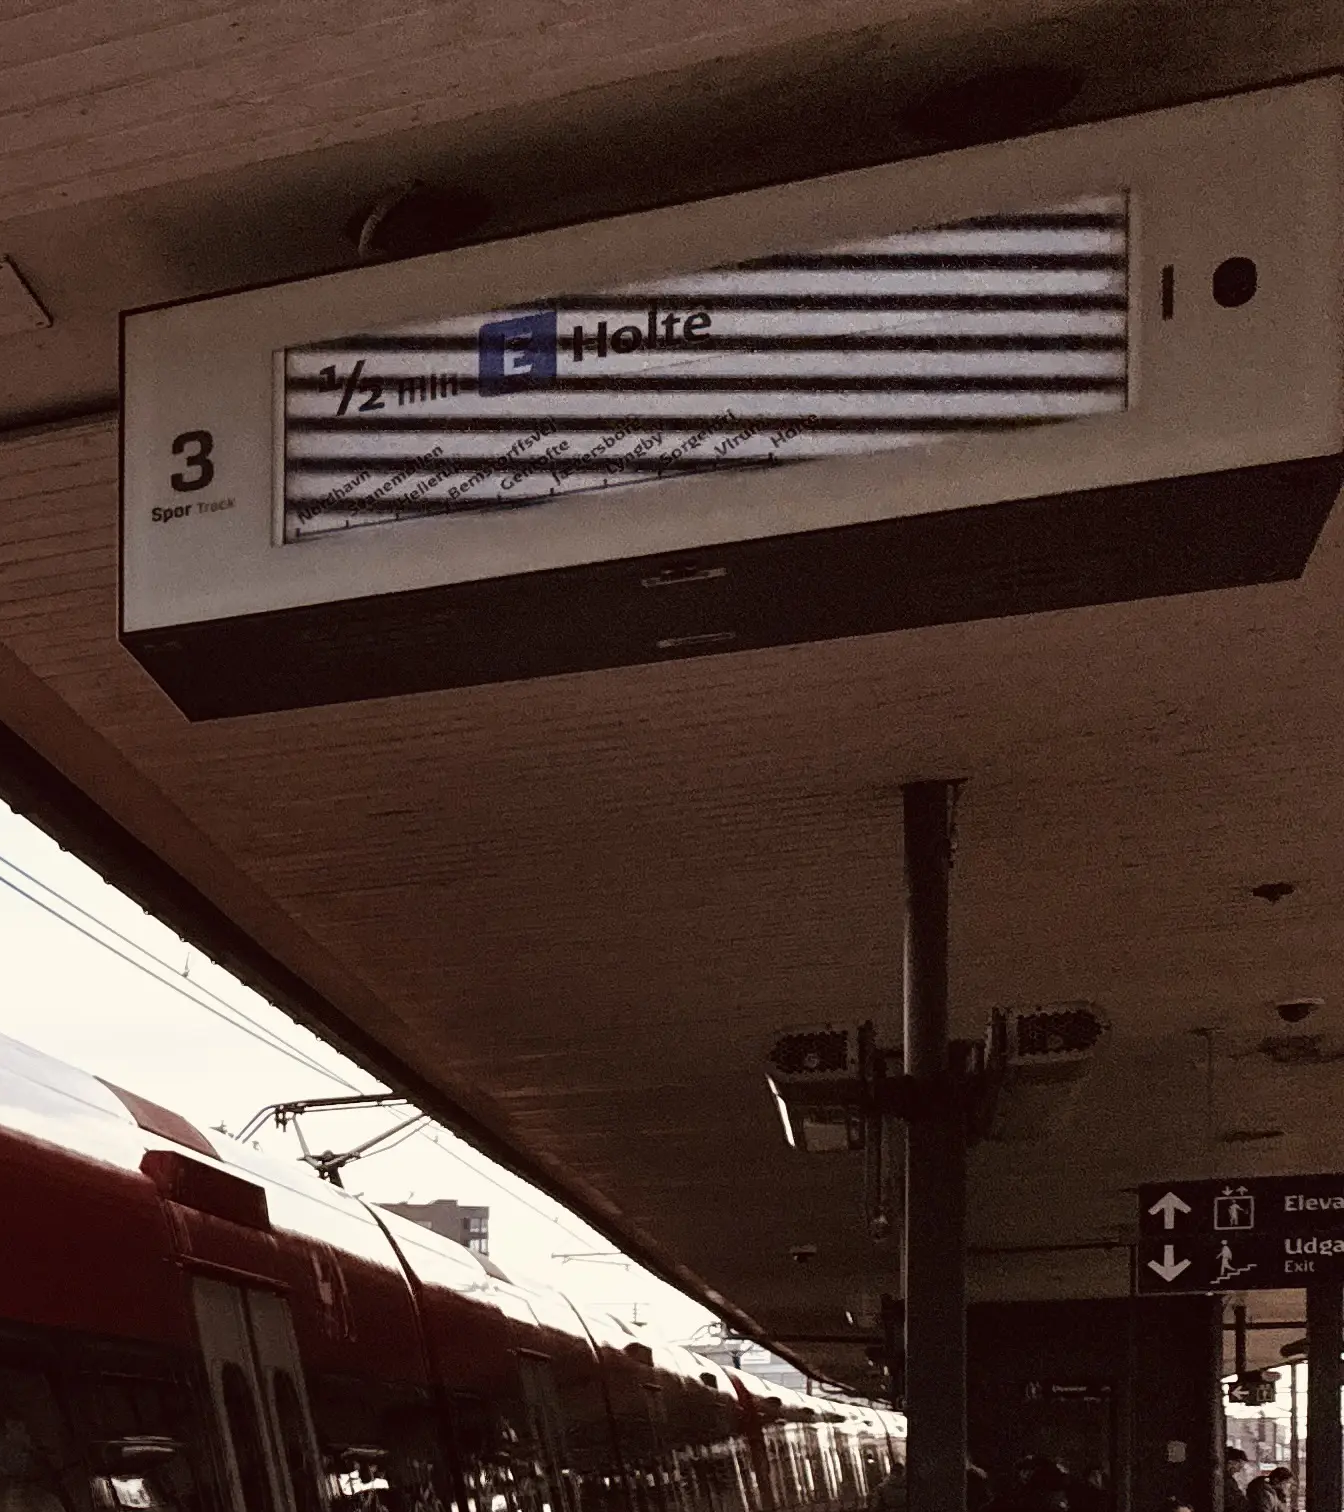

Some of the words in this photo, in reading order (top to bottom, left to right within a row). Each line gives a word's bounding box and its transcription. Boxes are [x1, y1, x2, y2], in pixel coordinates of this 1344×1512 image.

[573, 299, 712, 362] Holte
[503, 331, 534, 377] E
[171, 430, 214, 492] 3
[151, 504, 193, 523] Spor
[197, 497, 237, 514] Track
[1284, 1259, 1315, 1273] Exit
